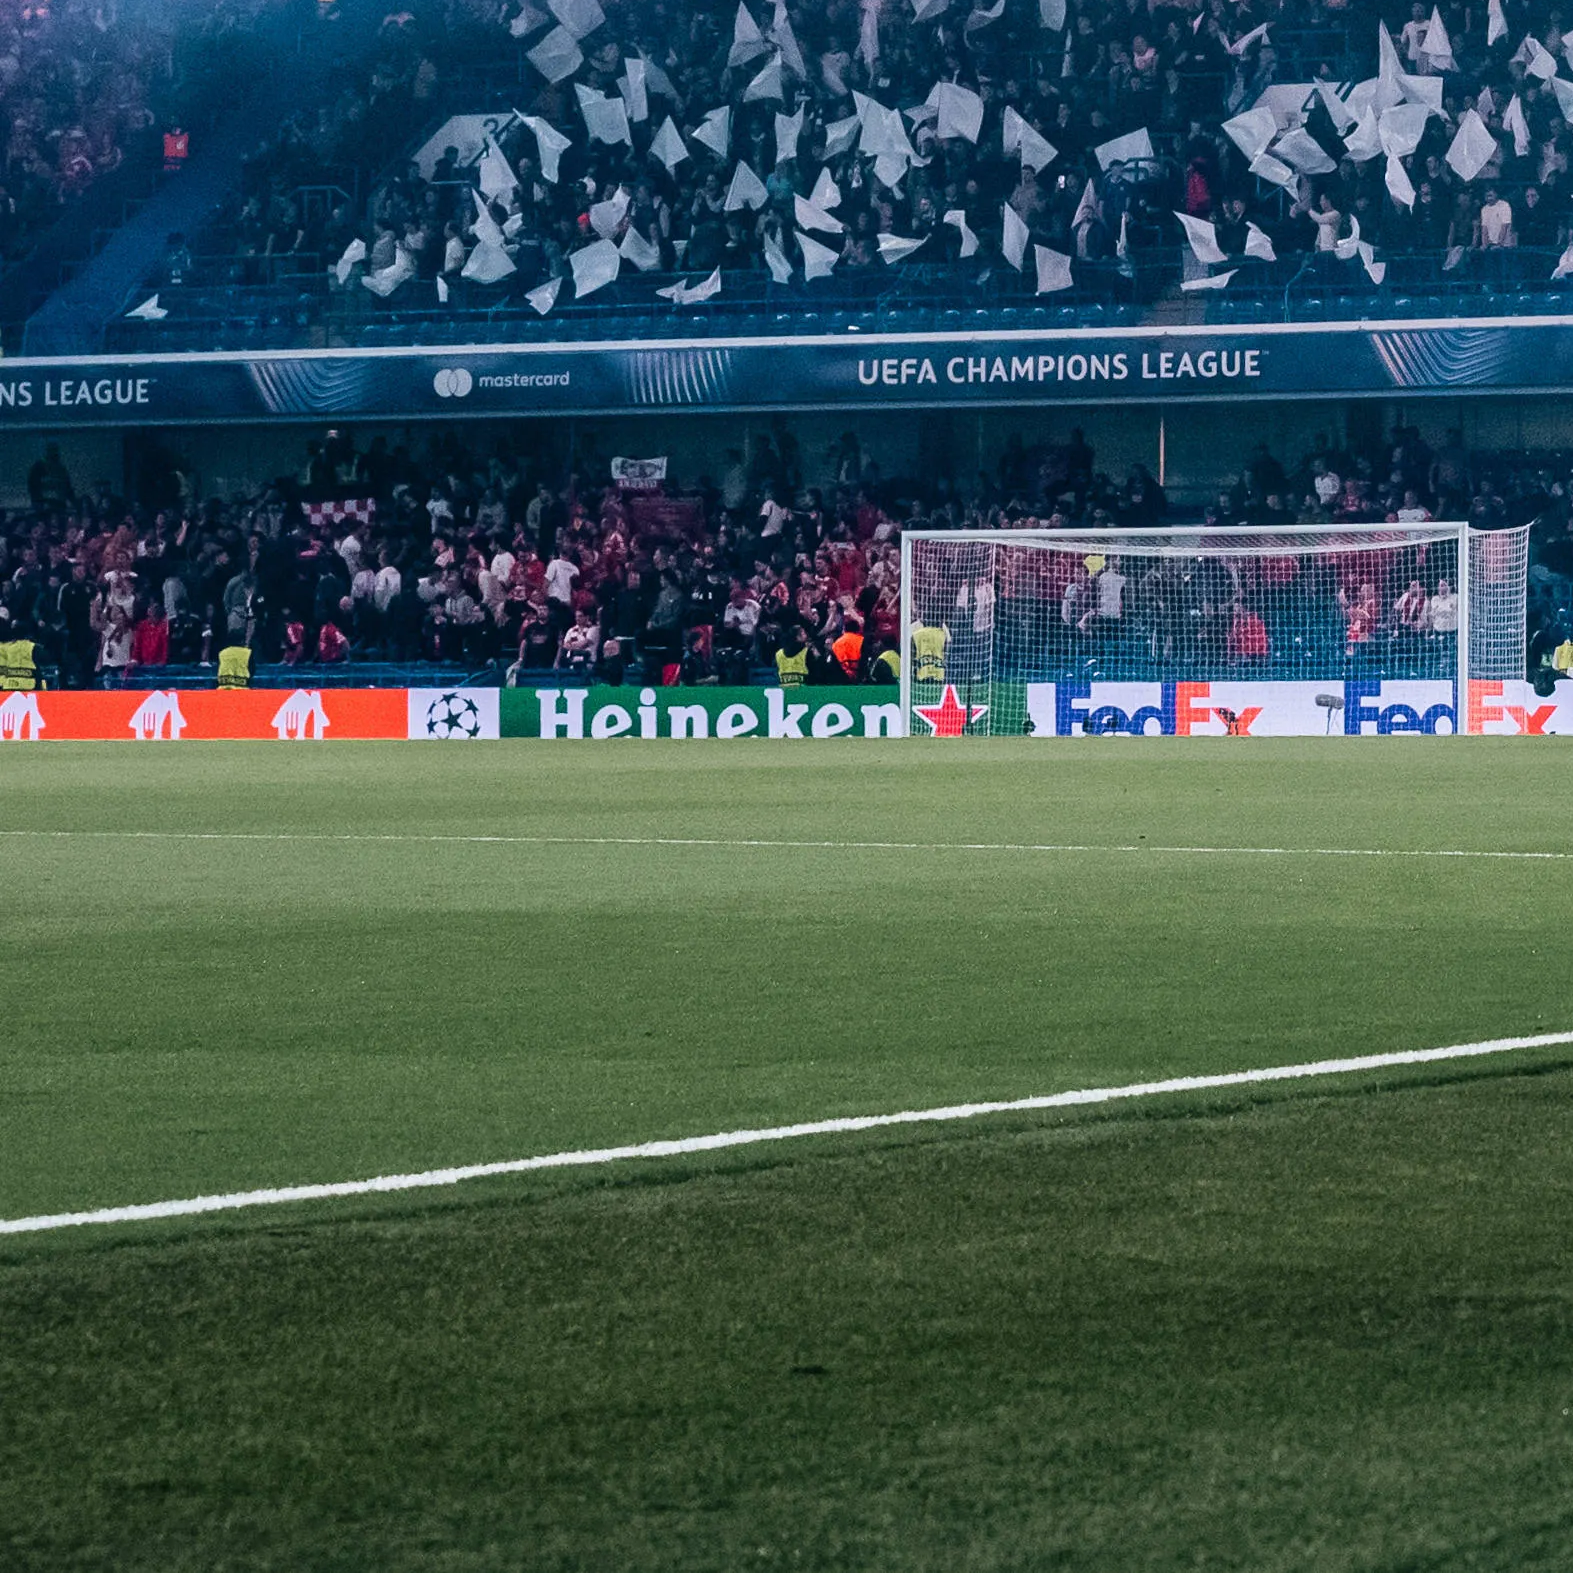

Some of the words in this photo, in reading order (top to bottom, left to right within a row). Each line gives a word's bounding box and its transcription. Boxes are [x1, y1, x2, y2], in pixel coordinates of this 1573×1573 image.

[479, 370, 570, 389] mastercard
[858, 357, 937, 385] UEFA
[947, 353, 1129, 383] CHAMPIONS
[1142, 349, 1261, 379] LEAGUE
[45, 379, 149, 405] LEAGUE
[535, 688, 901, 739] Heineken
[1056, 681, 1264, 736] FedEx
[1344, 679, 1562, 736] FedEx
